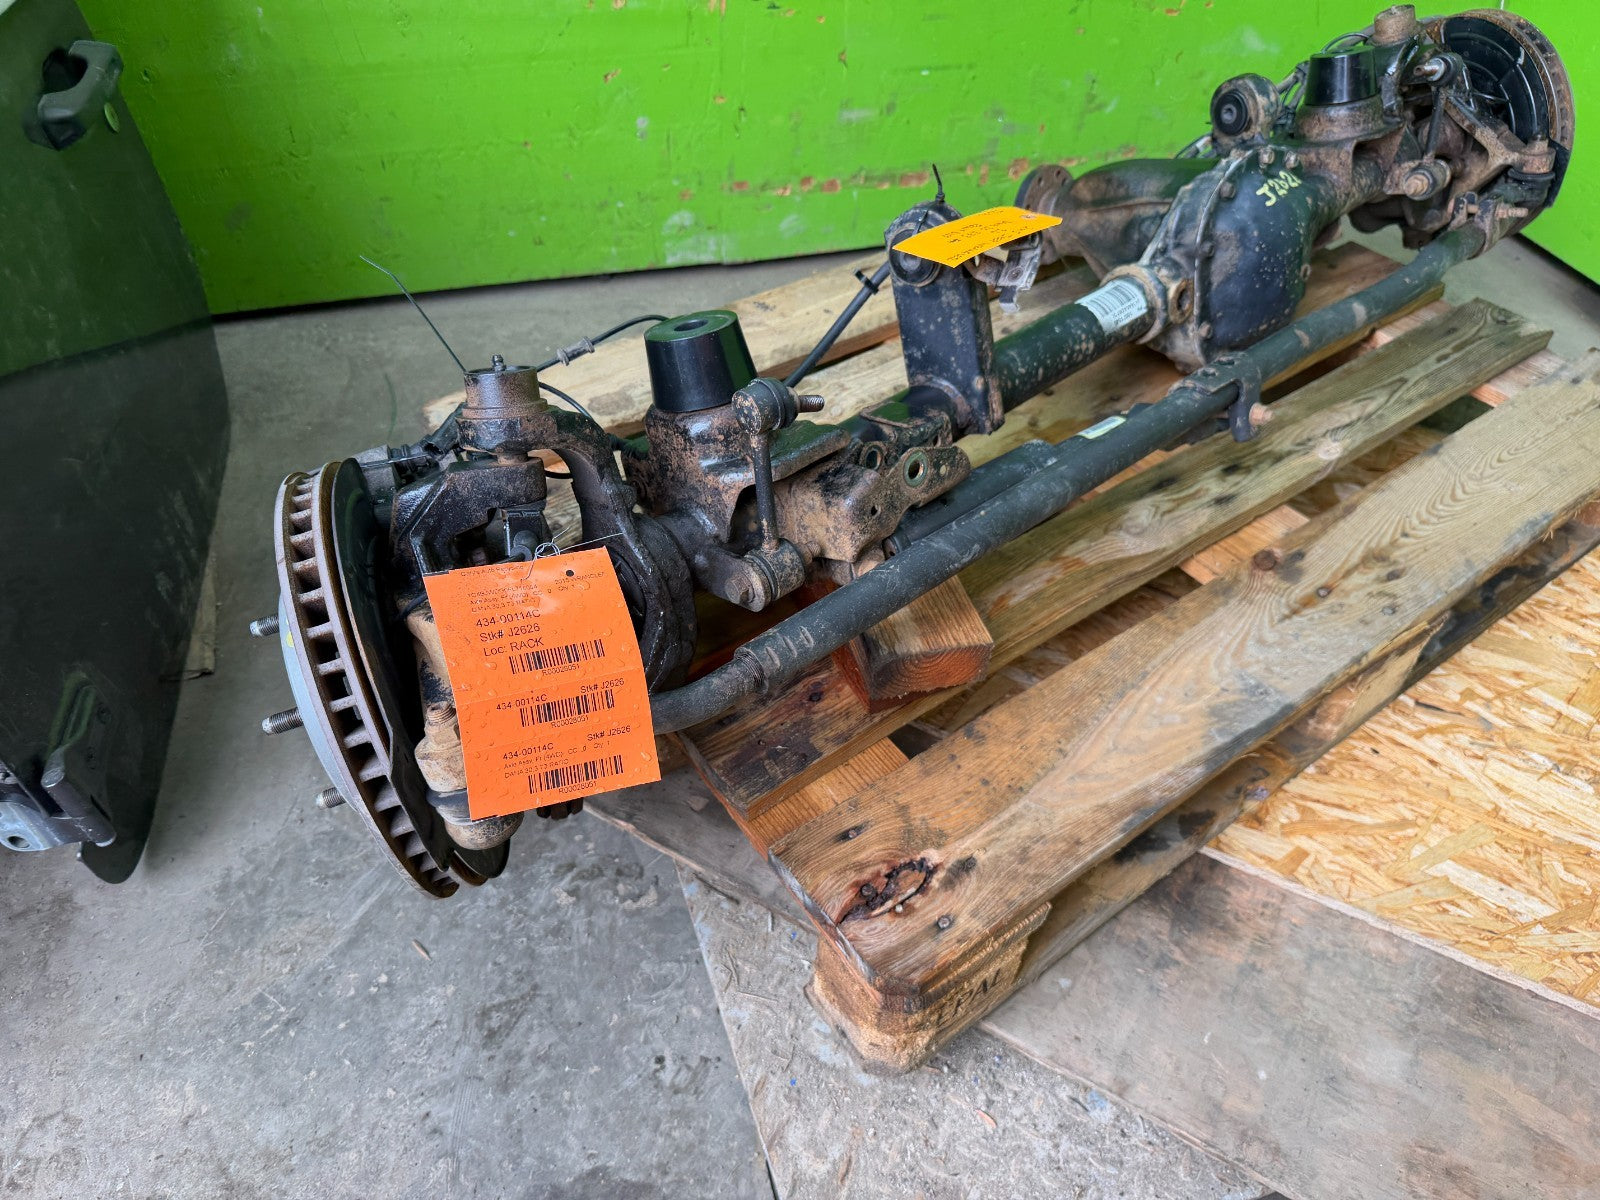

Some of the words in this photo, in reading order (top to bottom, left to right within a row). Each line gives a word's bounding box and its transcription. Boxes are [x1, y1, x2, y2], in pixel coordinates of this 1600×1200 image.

[476, 609, 541, 628] 434-00114C
[479, 629, 504, 643] Stk#
[508, 622, 541, 637] J2626
[483, 645, 508, 657] Loc:
[509, 636, 544, 652] RACK
[580, 683, 599, 695] Stk#
[600, 677, 625, 690] J2626
[496, 693, 548, 711] 434-00114C
[587, 730, 605, 742] Stk#
[607, 725, 631, 738] J2626
[503, 742, 554, 760] 434-00114C
